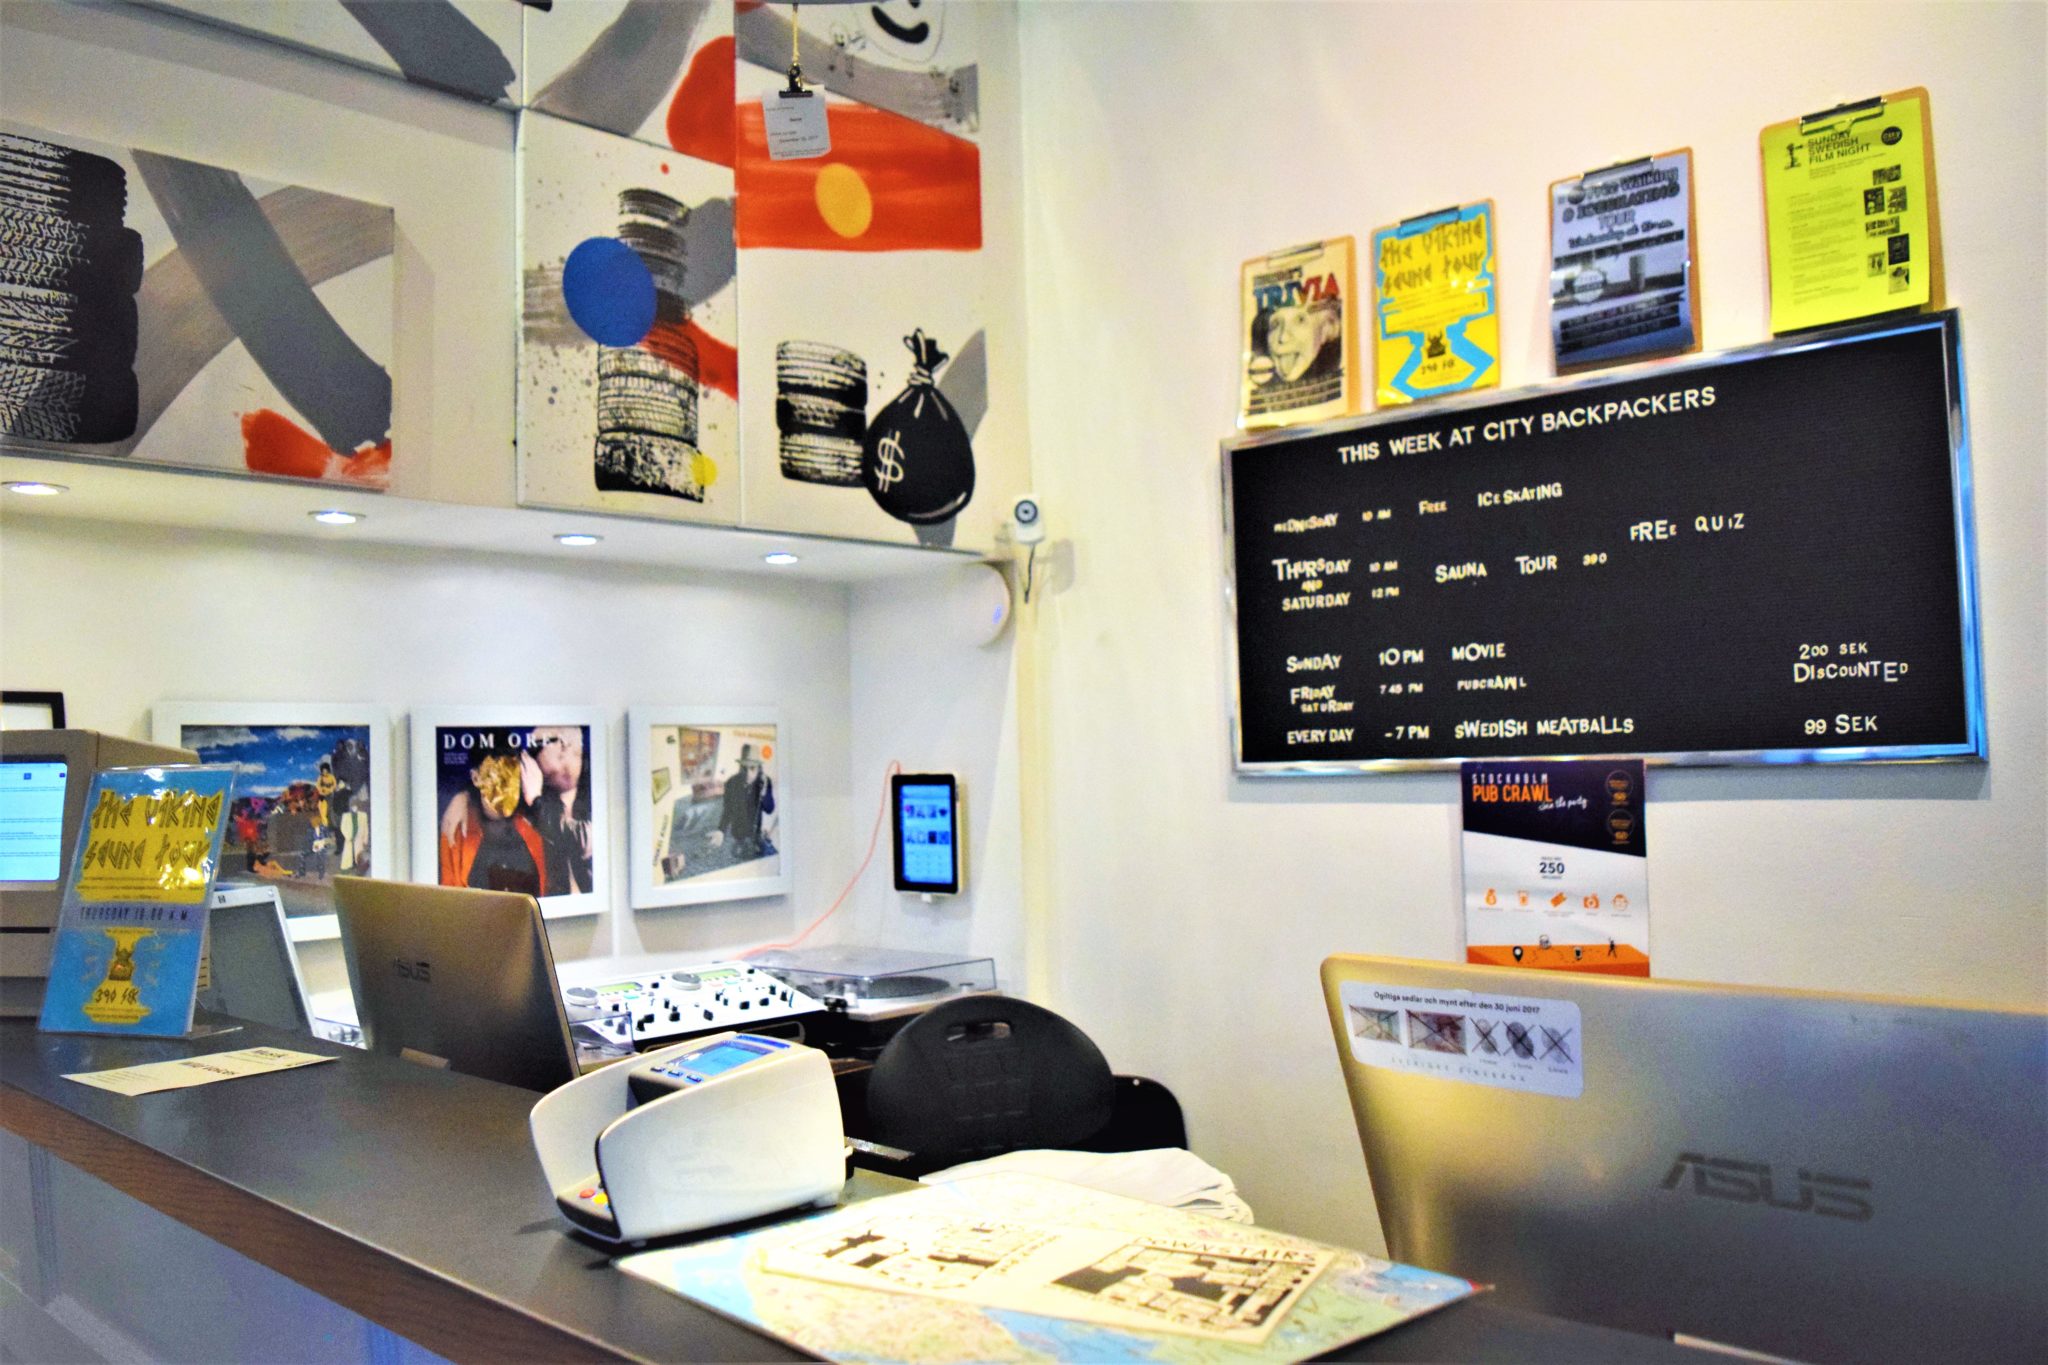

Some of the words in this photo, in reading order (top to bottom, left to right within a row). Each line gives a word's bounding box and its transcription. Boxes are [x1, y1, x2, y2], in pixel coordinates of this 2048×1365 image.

[1809, 153, 1835, 165] FILM
[1836, 143, 1872, 159] NIGHT
[1253, 271, 1341, 312] TRIVIA
[1337, 441, 1380, 465] THIS
[1388, 431, 1443, 456] WEEK
[1449, 425, 1475, 447] AT
[1483, 416, 1535, 442] CITY
[1541, 386, 1716, 433] BACKPACKERS
[1503, 482, 1563, 505] SKATING
[1630, 519, 1677, 541] FREE
[1694, 513, 1745, 532] QUIZ
[1271, 557, 1352, 581] THURSDAY
[1435, 561, 1488, 583] SAUNA
[1515, 554, 1558, 575] TOUR
[1282, 592, 1351, 612] SATURDAY
[1286, 653, 1342, 673] SUNDAY
[1379, 647, 1400, 666] 10
[1402, 649, 1425, 664] PM
[1452, 643, 1507, 661] MOVIE
[1799, 643, 1829, 660] 200
[1839, 642, 1868, 655] SEK
[1290, 685, 1336, 705] FRIDAY
[1408, 725, 1430, 739] PM
[1454, 719, 1528, 739] SWEDISH
[1536, 715, 1635, 736] MEATBALLS
[1804, 719, 1827, 735] 99
[1834, 714, 1878, 734] SEK
[443, 732, 495, 750] DOM
[1472, 784, 1499, 803] PUB
[1502, 784, 1553, 803] CRAWL
[1539, 861, 1566, 875] 250
[1424, 996, 1438, 1005] och
[1478, 1001, 1494, 1010] den
[1505, 1004, 1521, 1014] juni
[1659, 1150, 1876, 1223] ASUS
